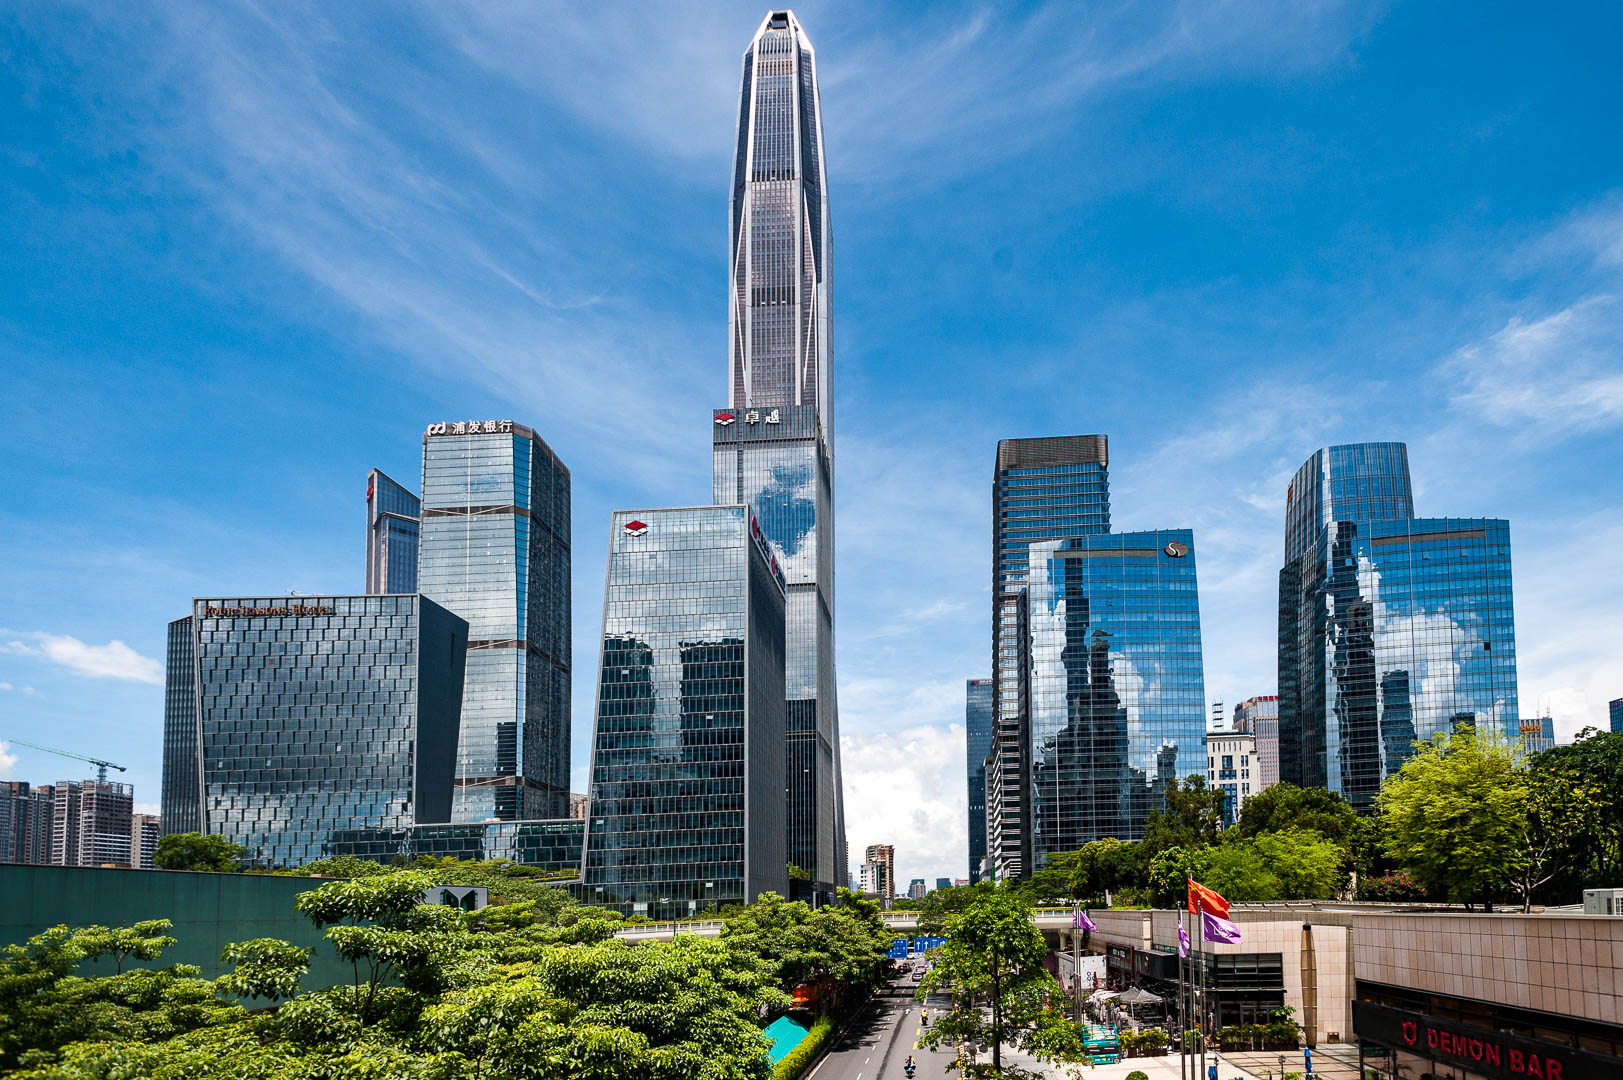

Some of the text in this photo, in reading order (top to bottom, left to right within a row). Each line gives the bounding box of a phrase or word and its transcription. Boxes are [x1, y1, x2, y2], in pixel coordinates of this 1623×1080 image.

[452, 419, 513, 435] 浦发银行
[1427, 1027, 1563, 1080] DEMON BAR
